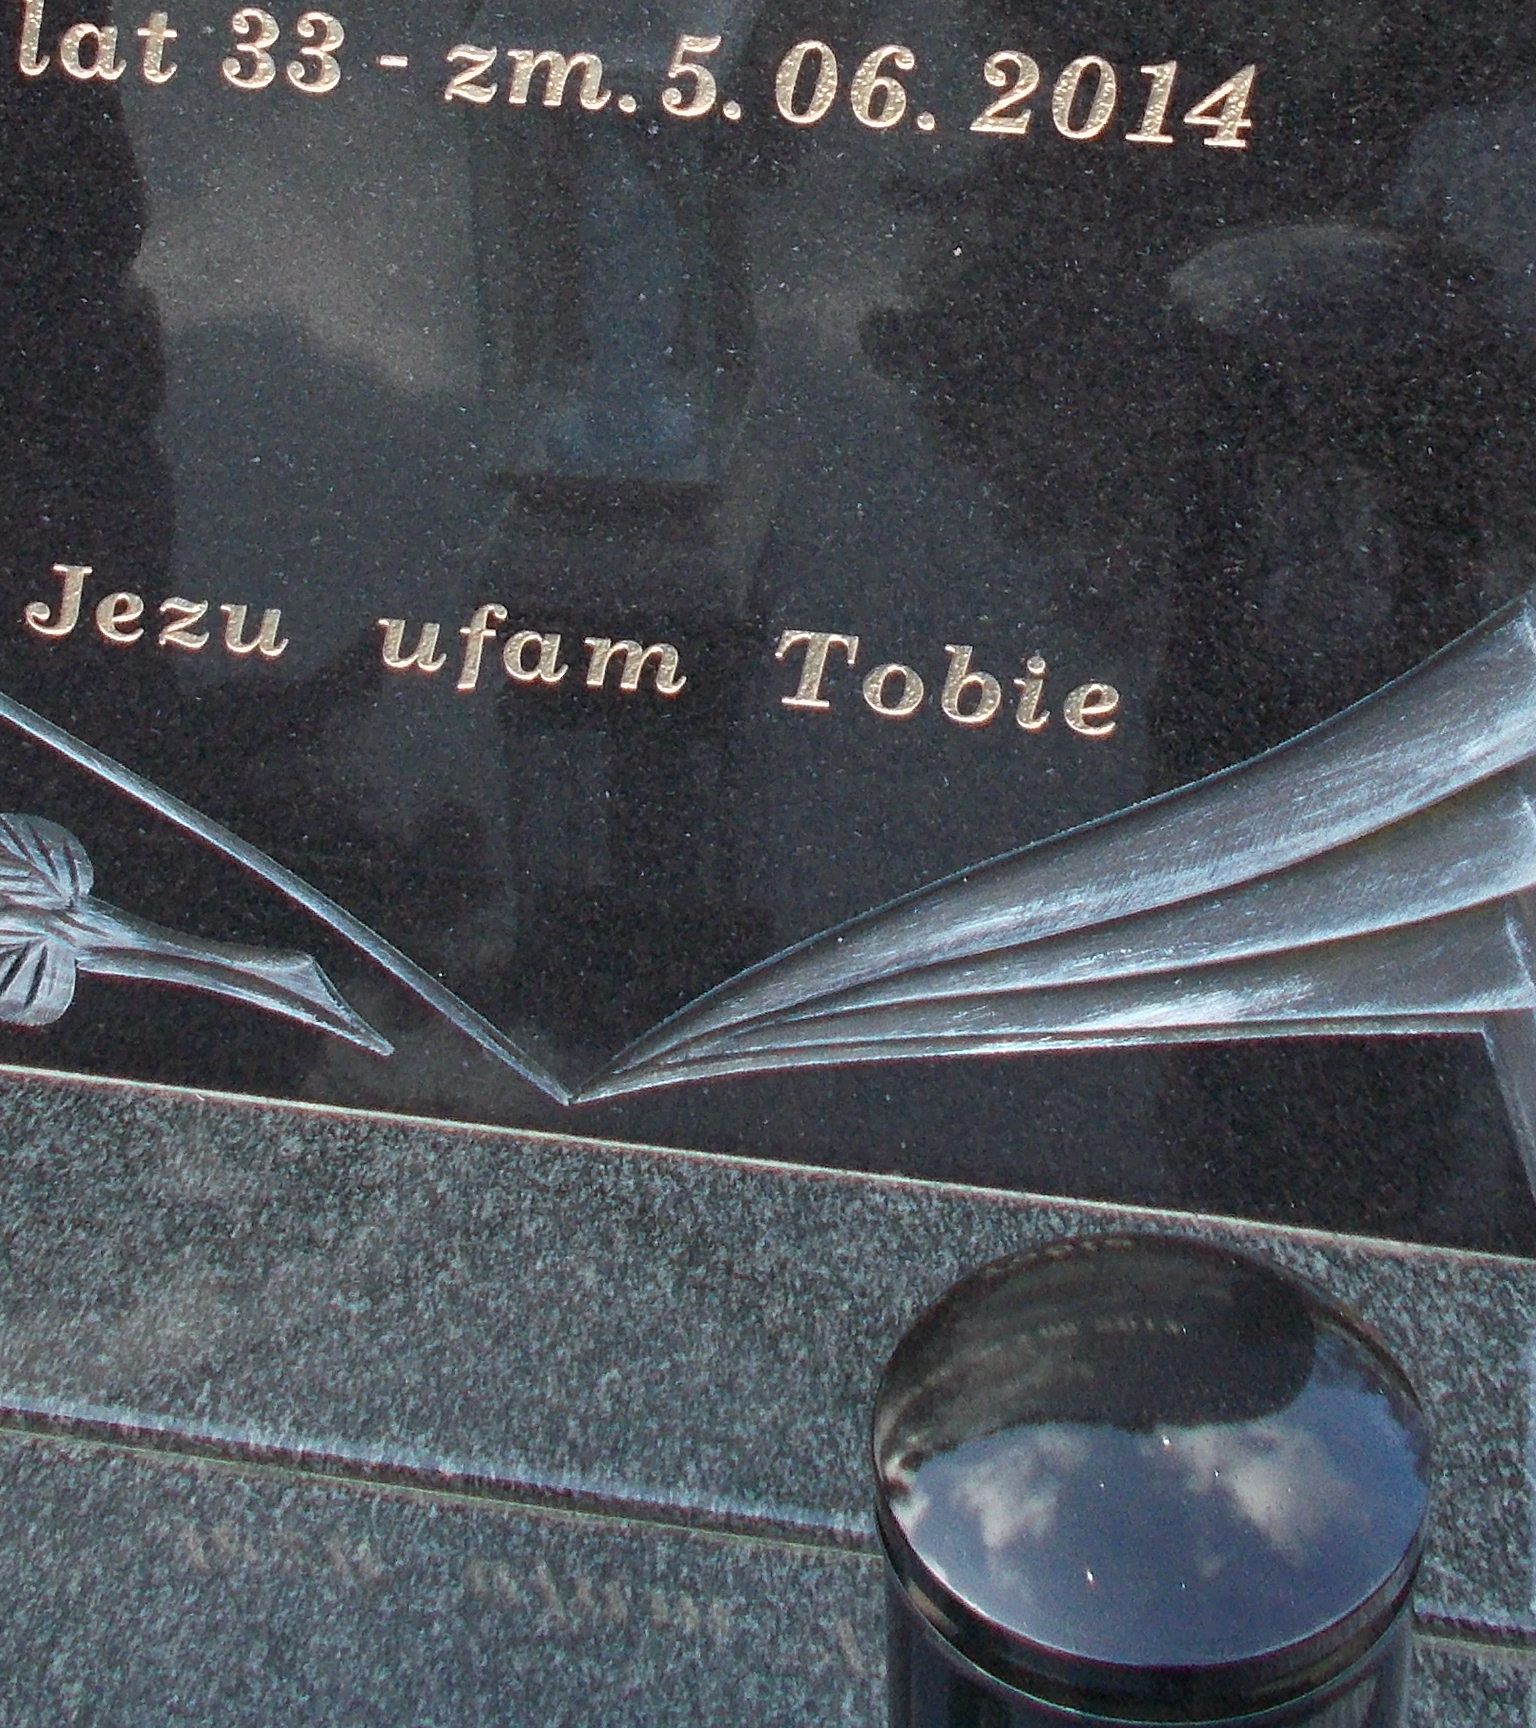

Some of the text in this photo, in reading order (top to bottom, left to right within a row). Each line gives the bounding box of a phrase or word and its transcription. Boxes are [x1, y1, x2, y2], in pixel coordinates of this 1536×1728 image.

[221, 6, 346, 95] 33
[23, 562, 1122, 736] Jezu ufam Tobie
